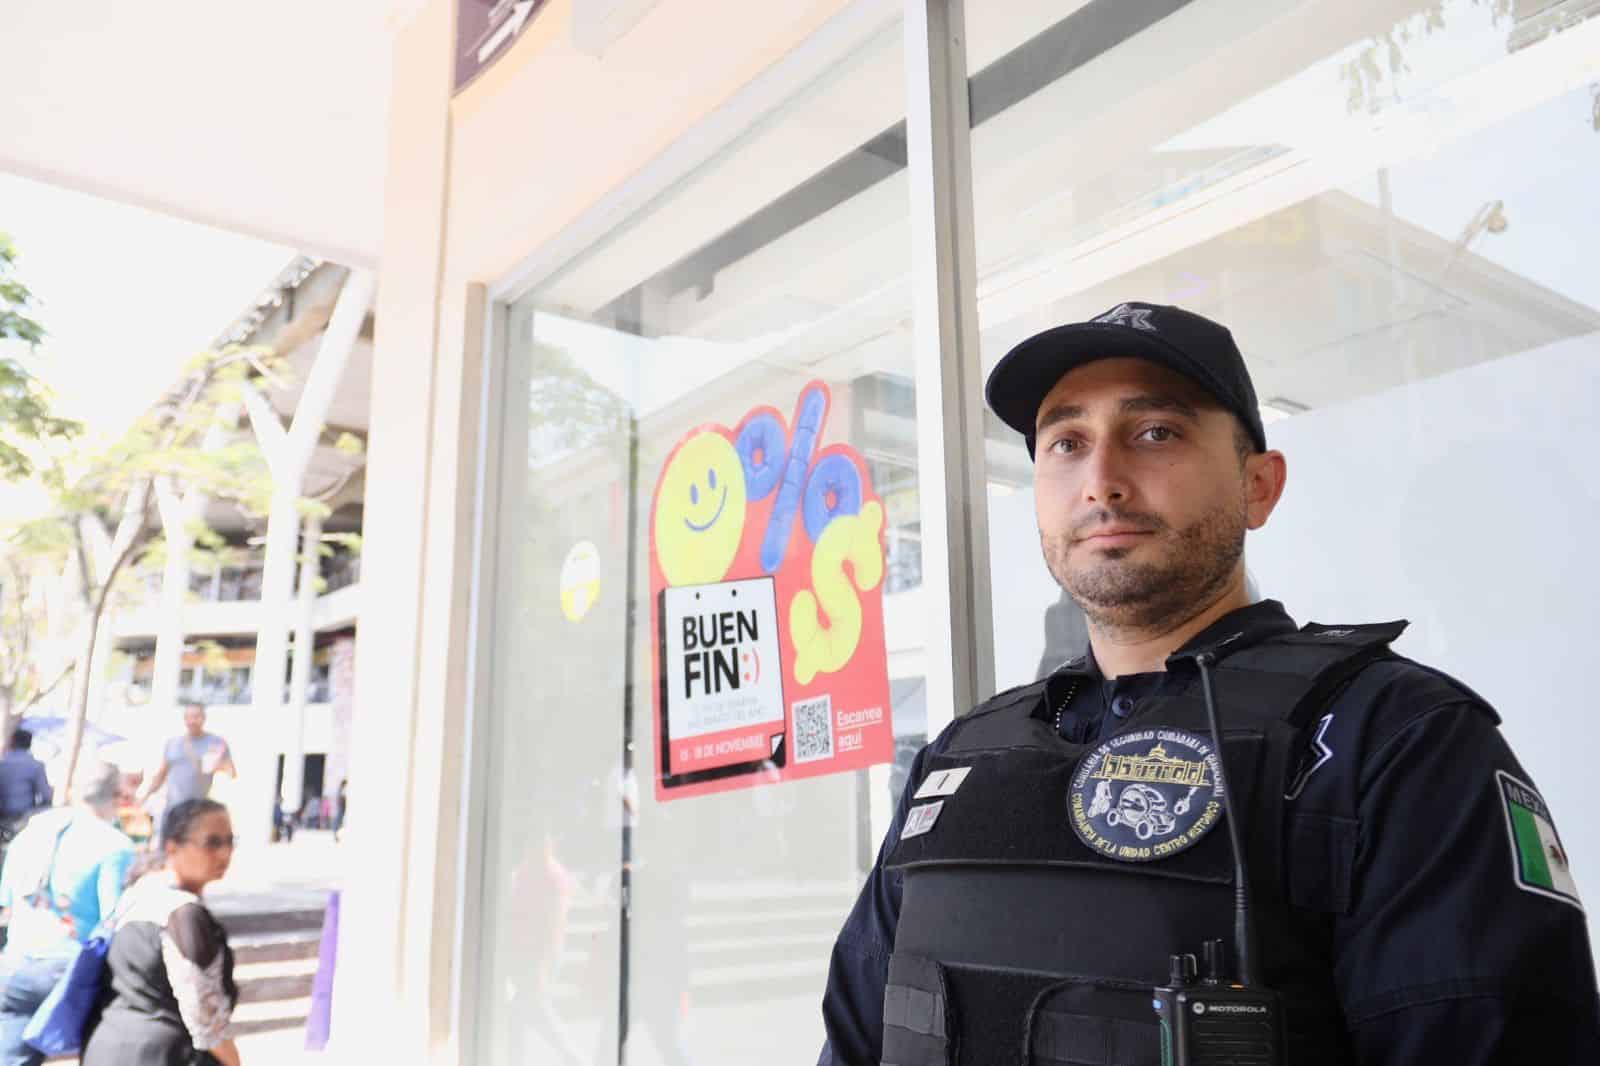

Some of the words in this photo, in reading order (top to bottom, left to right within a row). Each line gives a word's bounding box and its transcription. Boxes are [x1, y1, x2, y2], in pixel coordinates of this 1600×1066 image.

[683, 610, 758, 650] BUEN
[836, 706, 883, 726] Escanea
[715, 734, 764, 755] NOVIEMBRE
[1110, 731, 1155, 748] SEGURIDAD
[1119, 847, 1150, 858] UNIDAD
[1153, 835, 1188, 855] CENTRO
[1208, 1005, 1267, 1013] MOTOROLA
